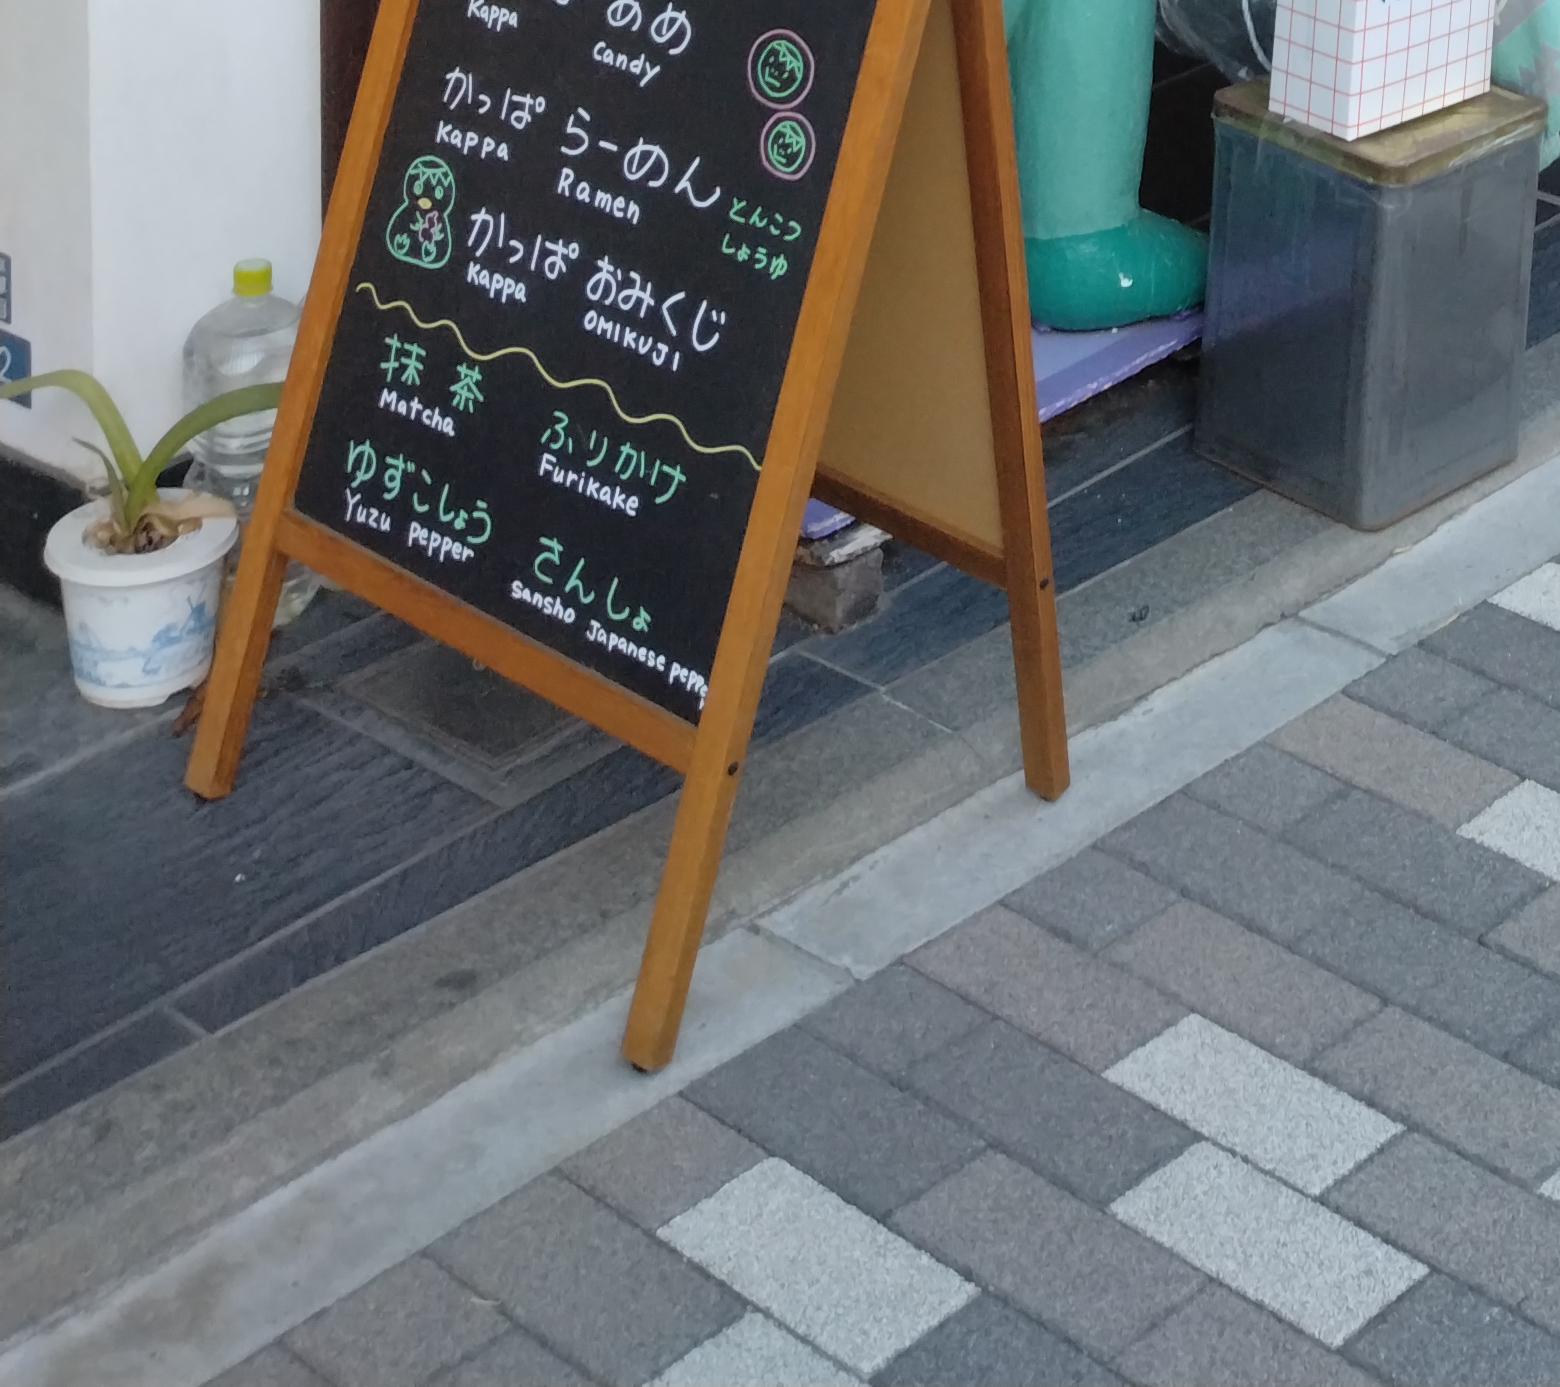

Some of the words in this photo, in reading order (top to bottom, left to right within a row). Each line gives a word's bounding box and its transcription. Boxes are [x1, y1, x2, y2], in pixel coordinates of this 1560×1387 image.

[434, 120, 511, 164] Kappa
[557, 166, 642, 225] Ramen
[720, 231, 789, 279] しょうゆ
[728, 194, 803, 241] とんこつ
[466, 262, 528, 304] Kappa
[582, 310, 682, 372] OMIKUJI
[378, 386, 456, 439] Matcha
[380, 334, 486, 415] 抹茶
[346, 440, 492, 545] ゆずこしょう
[538, 452, 640, 518] Furikake
[540, 409, 687, 505] ふりかけ
[343, 488, 392, 535] Yuzu
[407, 519, 475, 567] pepper
[533, 536, 652, 632] さんしょ
[585, 618, 667, 672] Japanese
